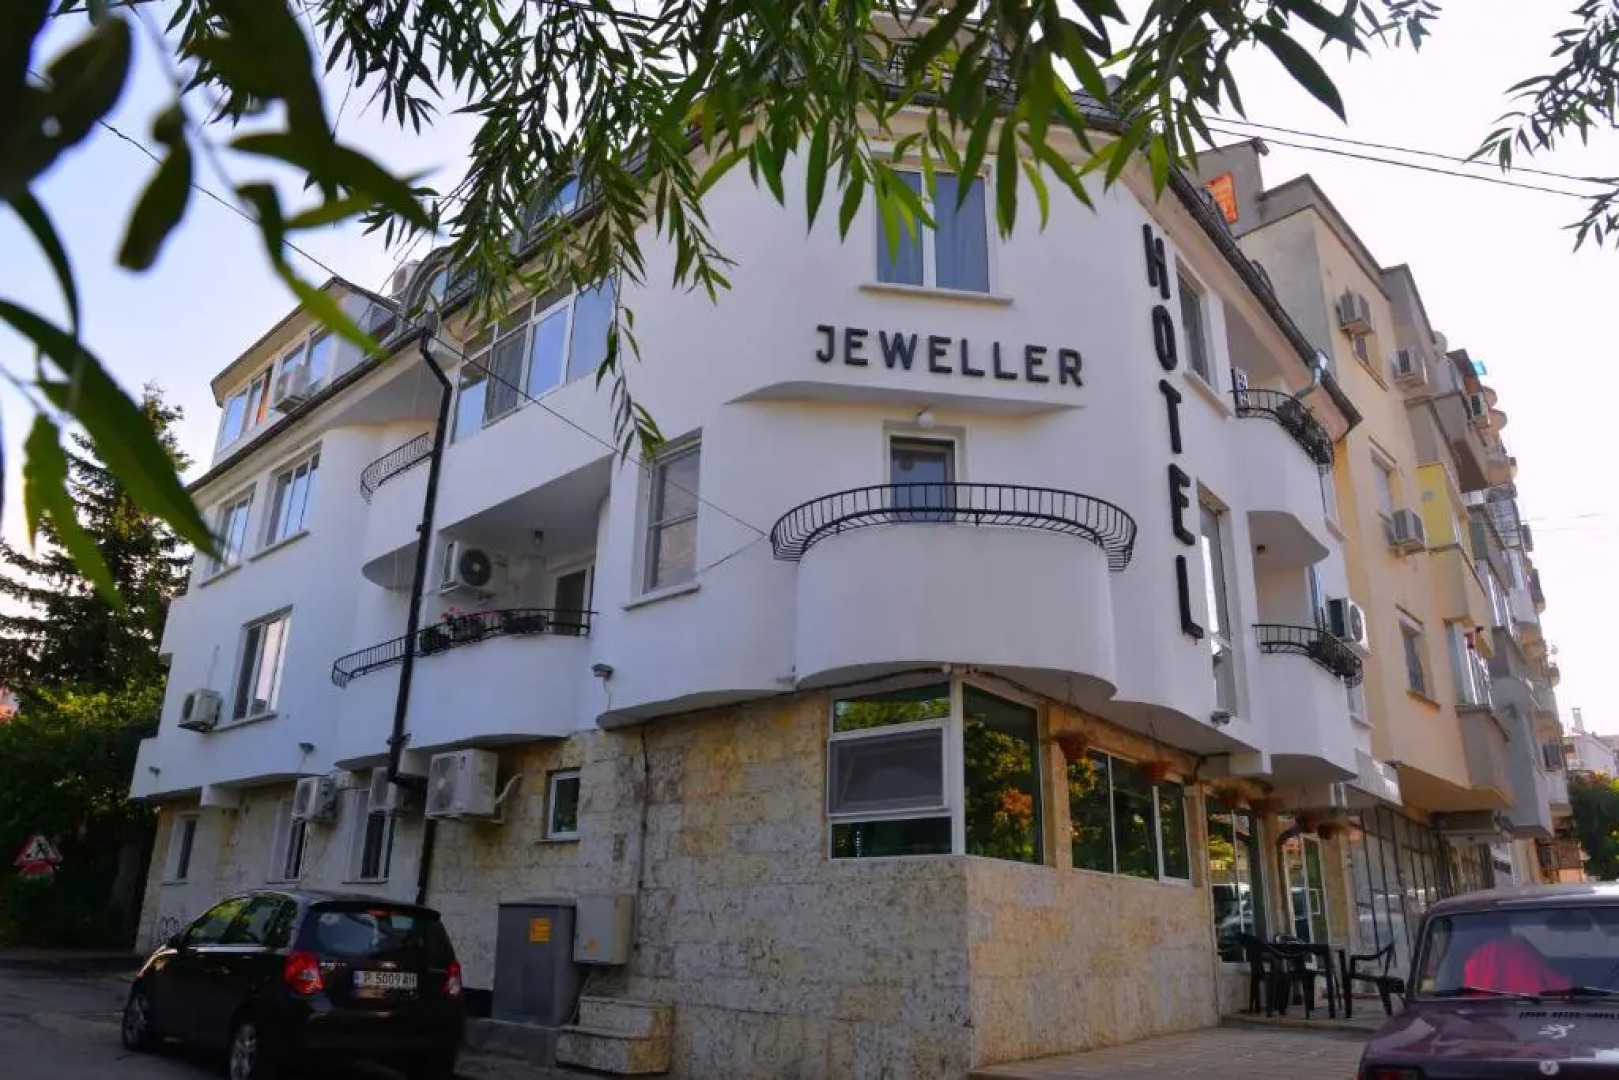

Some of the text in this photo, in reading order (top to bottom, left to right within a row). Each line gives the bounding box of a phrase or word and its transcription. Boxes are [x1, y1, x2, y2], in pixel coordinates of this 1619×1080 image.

[816, 324, 1084, 387] JEWELLER
[1142, 223, 1204, 640] HOTEL
[376, 973, 401, 985] 5009
